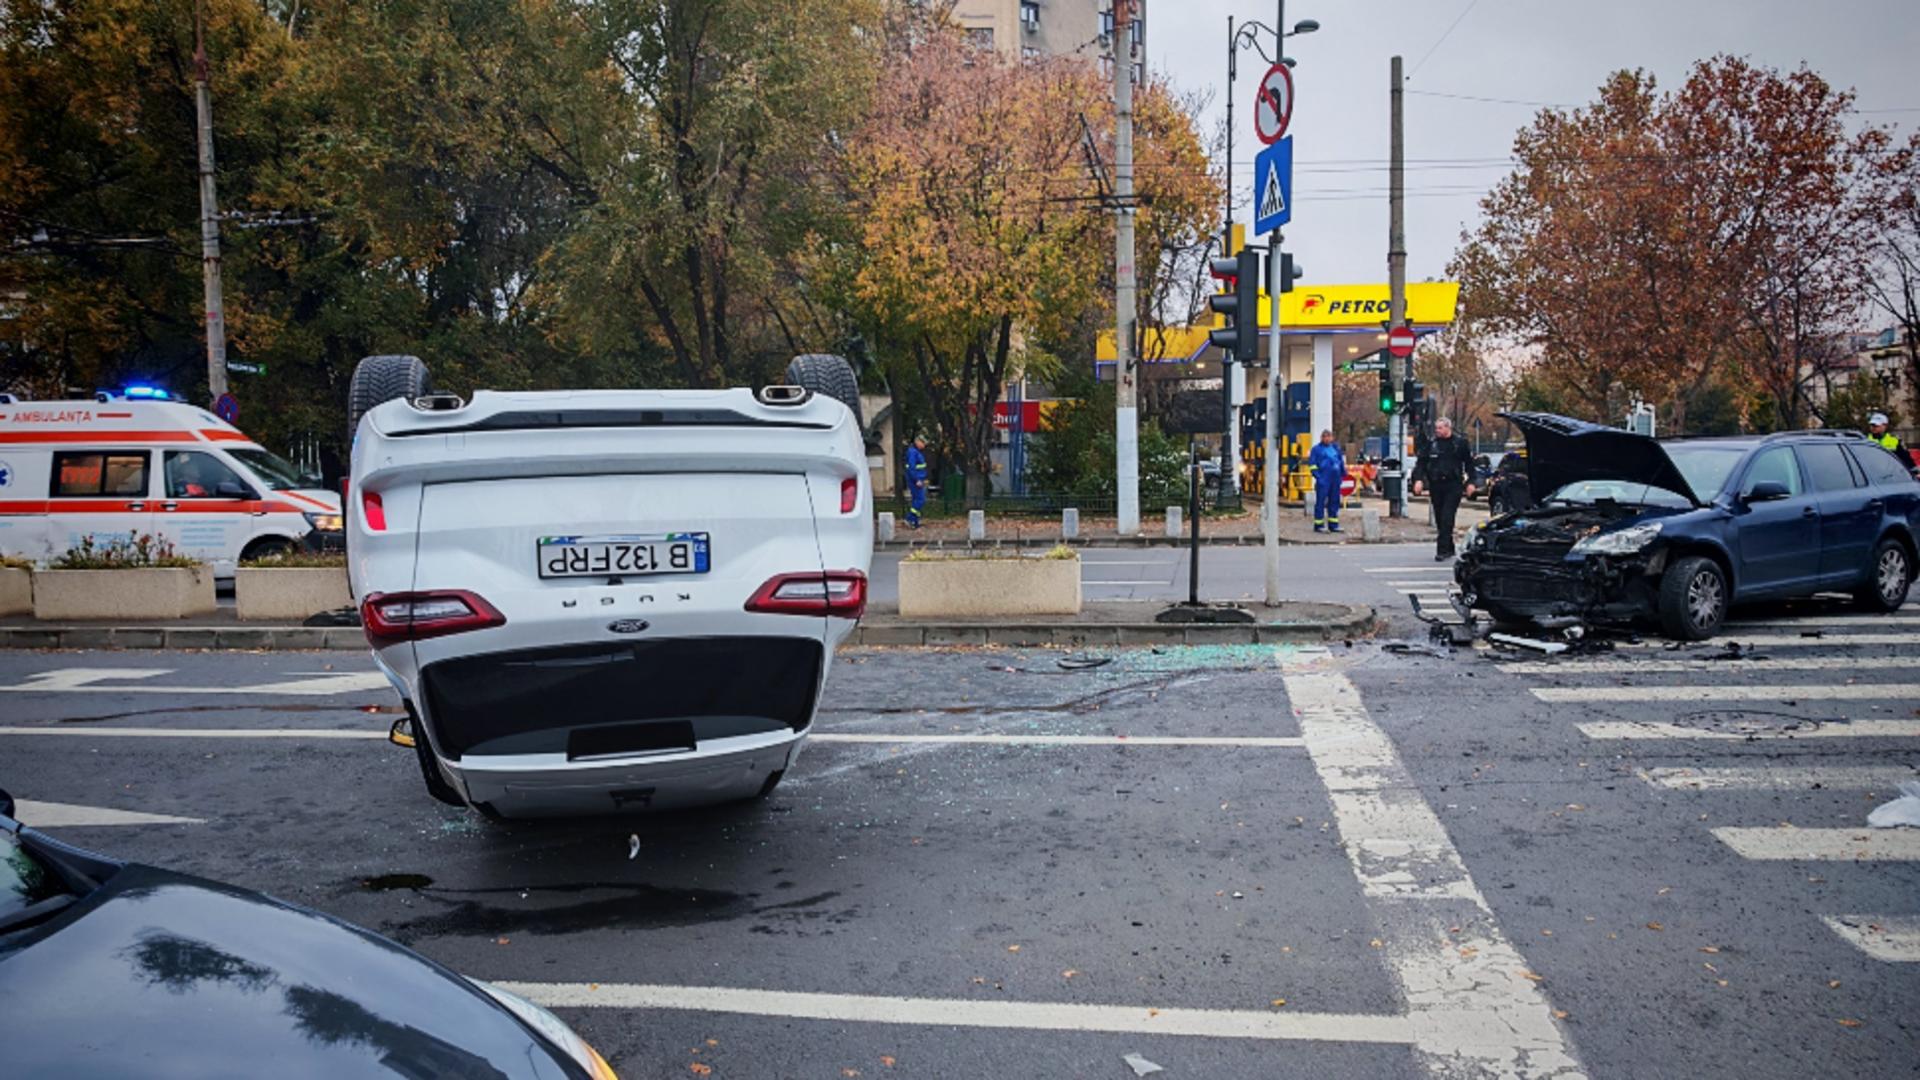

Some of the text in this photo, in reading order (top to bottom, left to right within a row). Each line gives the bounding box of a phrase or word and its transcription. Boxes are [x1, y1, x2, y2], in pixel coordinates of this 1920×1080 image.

[1328, 300, 1407, 314] PETRO
[670, 543, 689, 569] B
[562, 592, 691, 608] KUGA
